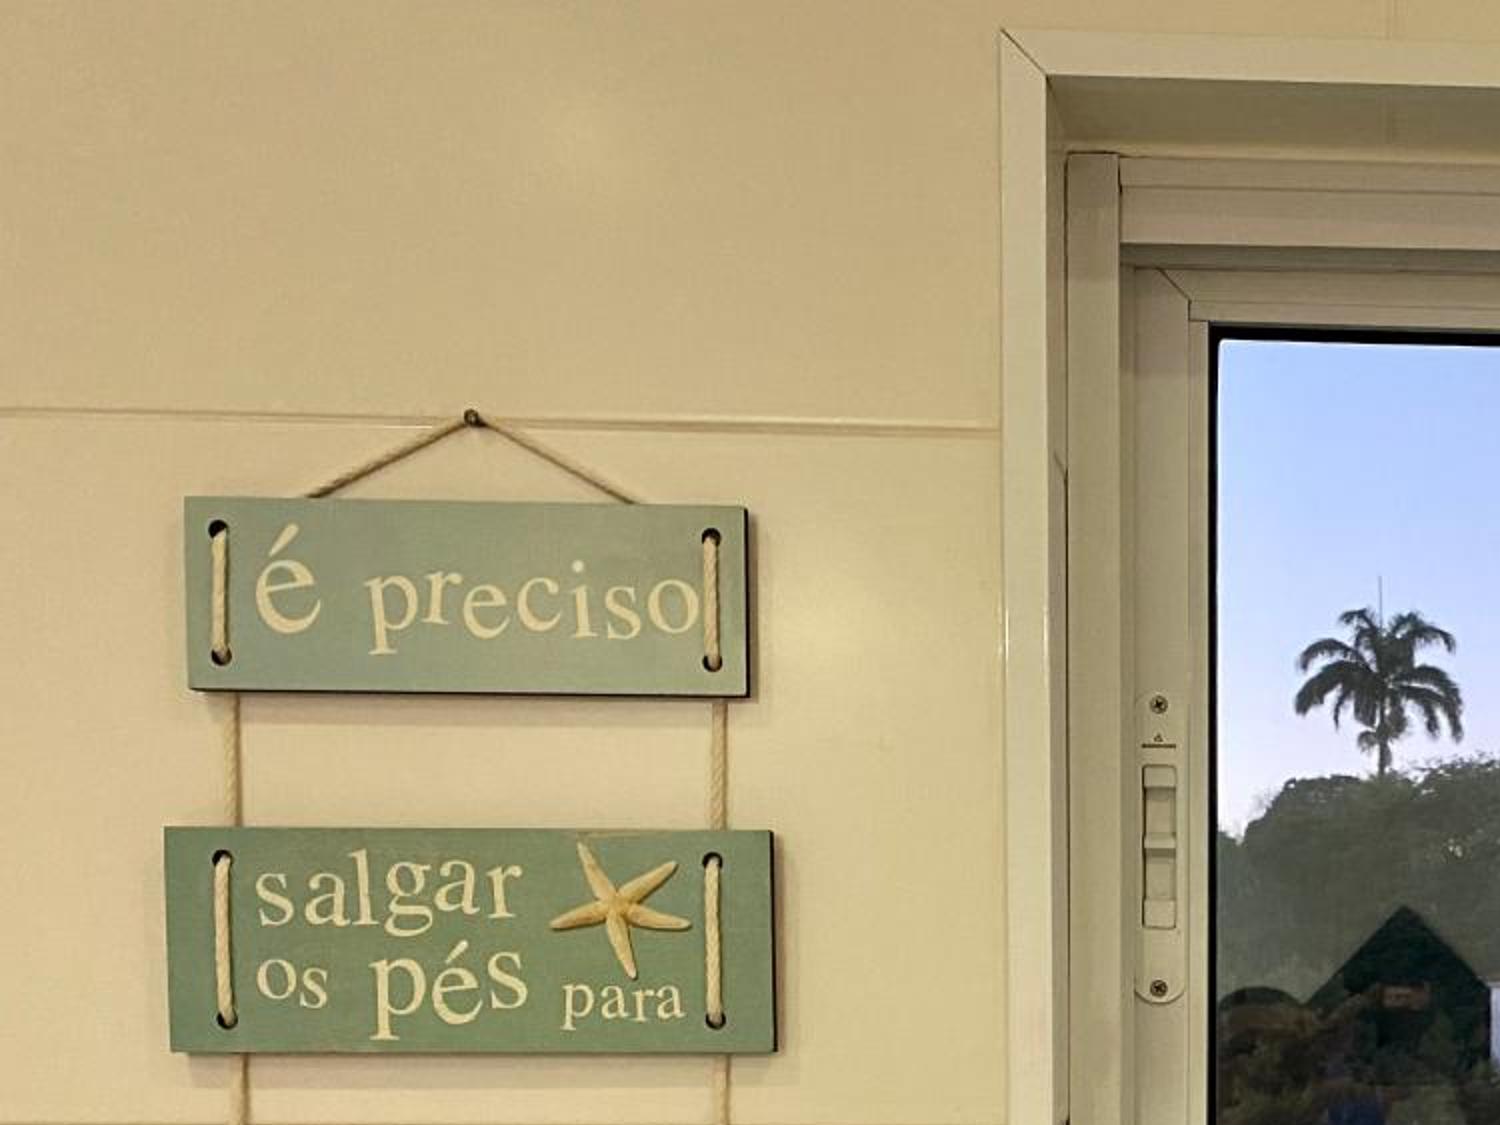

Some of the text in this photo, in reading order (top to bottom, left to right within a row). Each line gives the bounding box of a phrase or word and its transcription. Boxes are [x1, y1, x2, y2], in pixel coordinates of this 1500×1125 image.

[254, 524, 700, 656] é preciso
[254, 849, 523, 938] salgar
[256, 940, 687, 1041] os pés para
